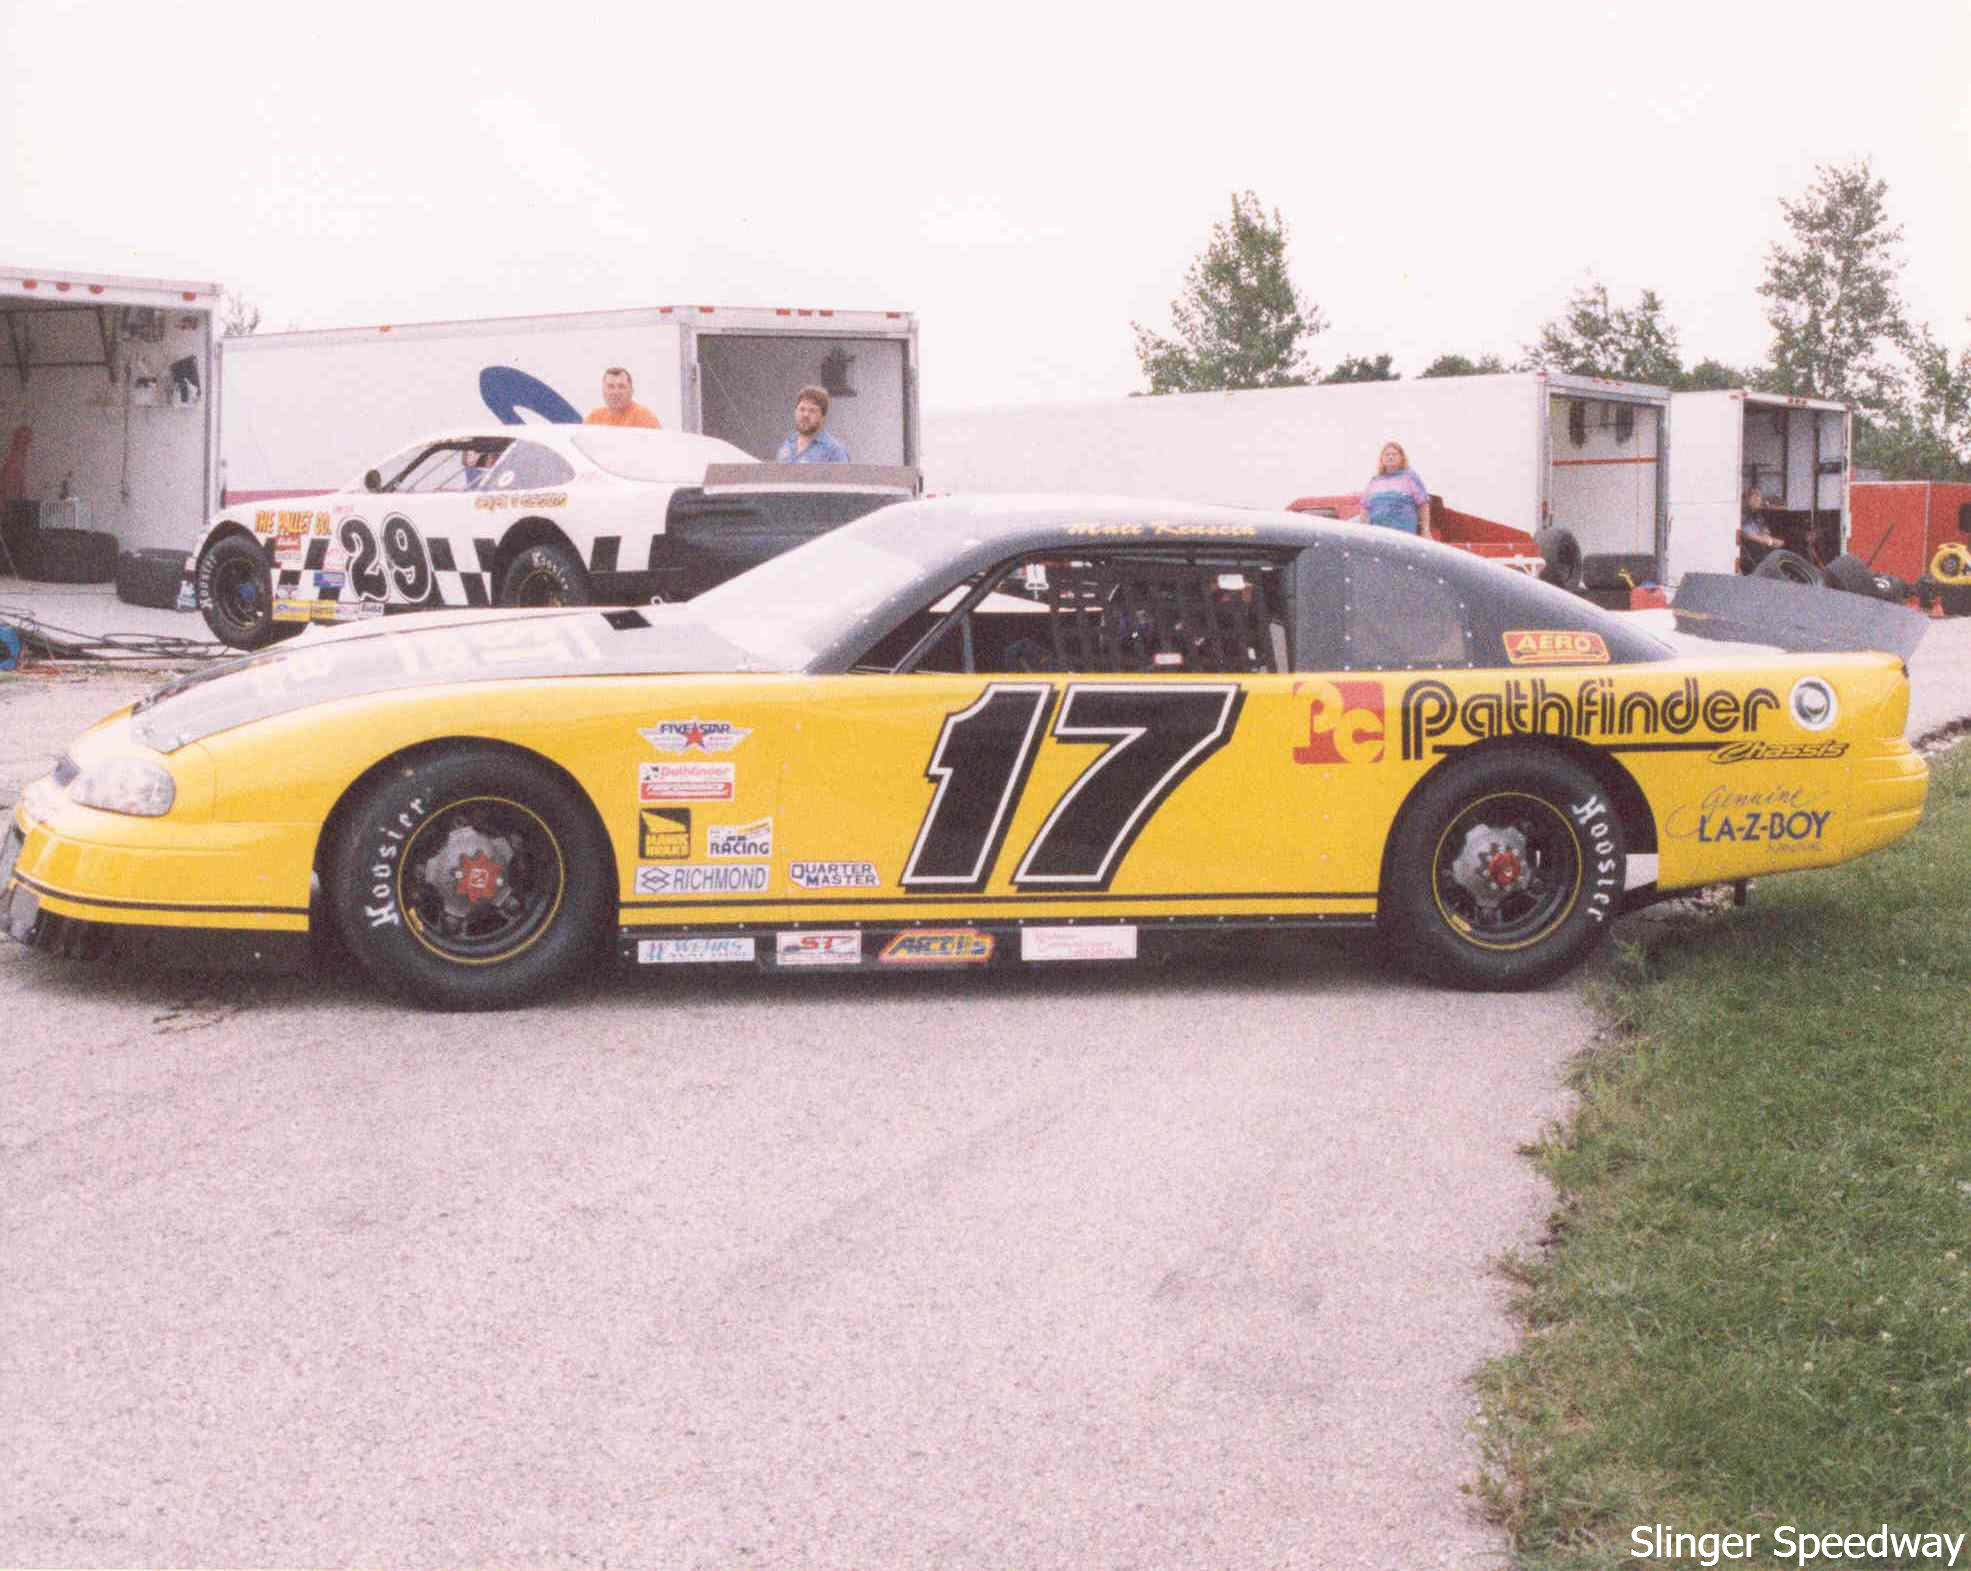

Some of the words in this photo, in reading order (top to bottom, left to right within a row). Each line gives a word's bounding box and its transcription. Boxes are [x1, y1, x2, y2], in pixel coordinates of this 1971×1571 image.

[337, 511, 432, 603] 29
[1517, 634, 1593, 653] AERO
[659, 723, 690, 735] FIVE
[699, 723, 731, 735] STAR
[1401, 677, 1780, 760] Pathfinder
[1708, 739, 1850, 764] Chassis
[899, 682, 1249, 893] 17
[1698, 811, 1832, 842] LA-Z-BOY
[709, 842, 770, 855] RACING
[1572, 795, 1616, 922] Hoosier
[364, 798, 425, 927] Hoosier
[791, 863, 872, 879] QUARTER
[673, 867, 767, 890] RICHMOND
[806, 874, 877, 886] MASTER
